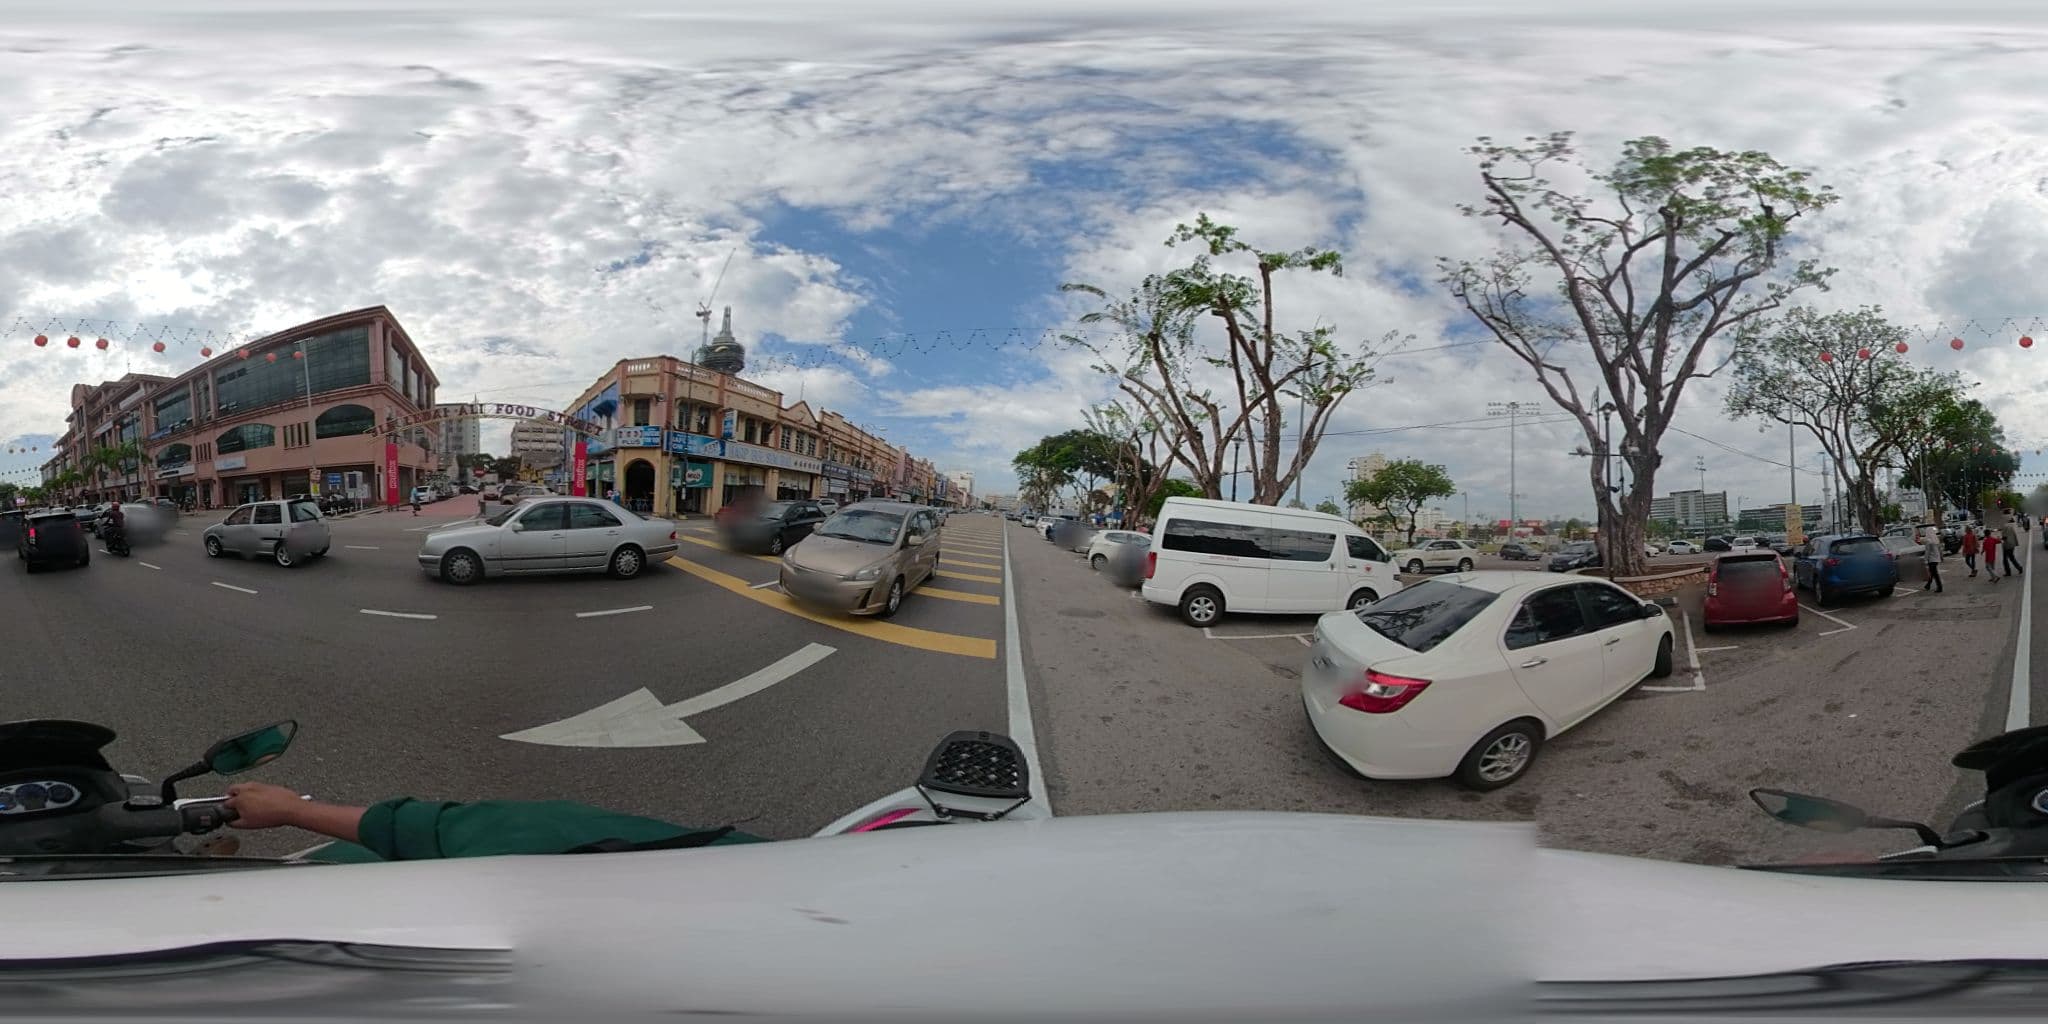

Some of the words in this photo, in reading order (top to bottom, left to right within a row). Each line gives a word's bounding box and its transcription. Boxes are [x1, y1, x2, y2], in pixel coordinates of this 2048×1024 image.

[458, 403, 484, 416] ALI
[495, 403, 535, 418] FOOD
[547, 412, 604, 437] STREET
